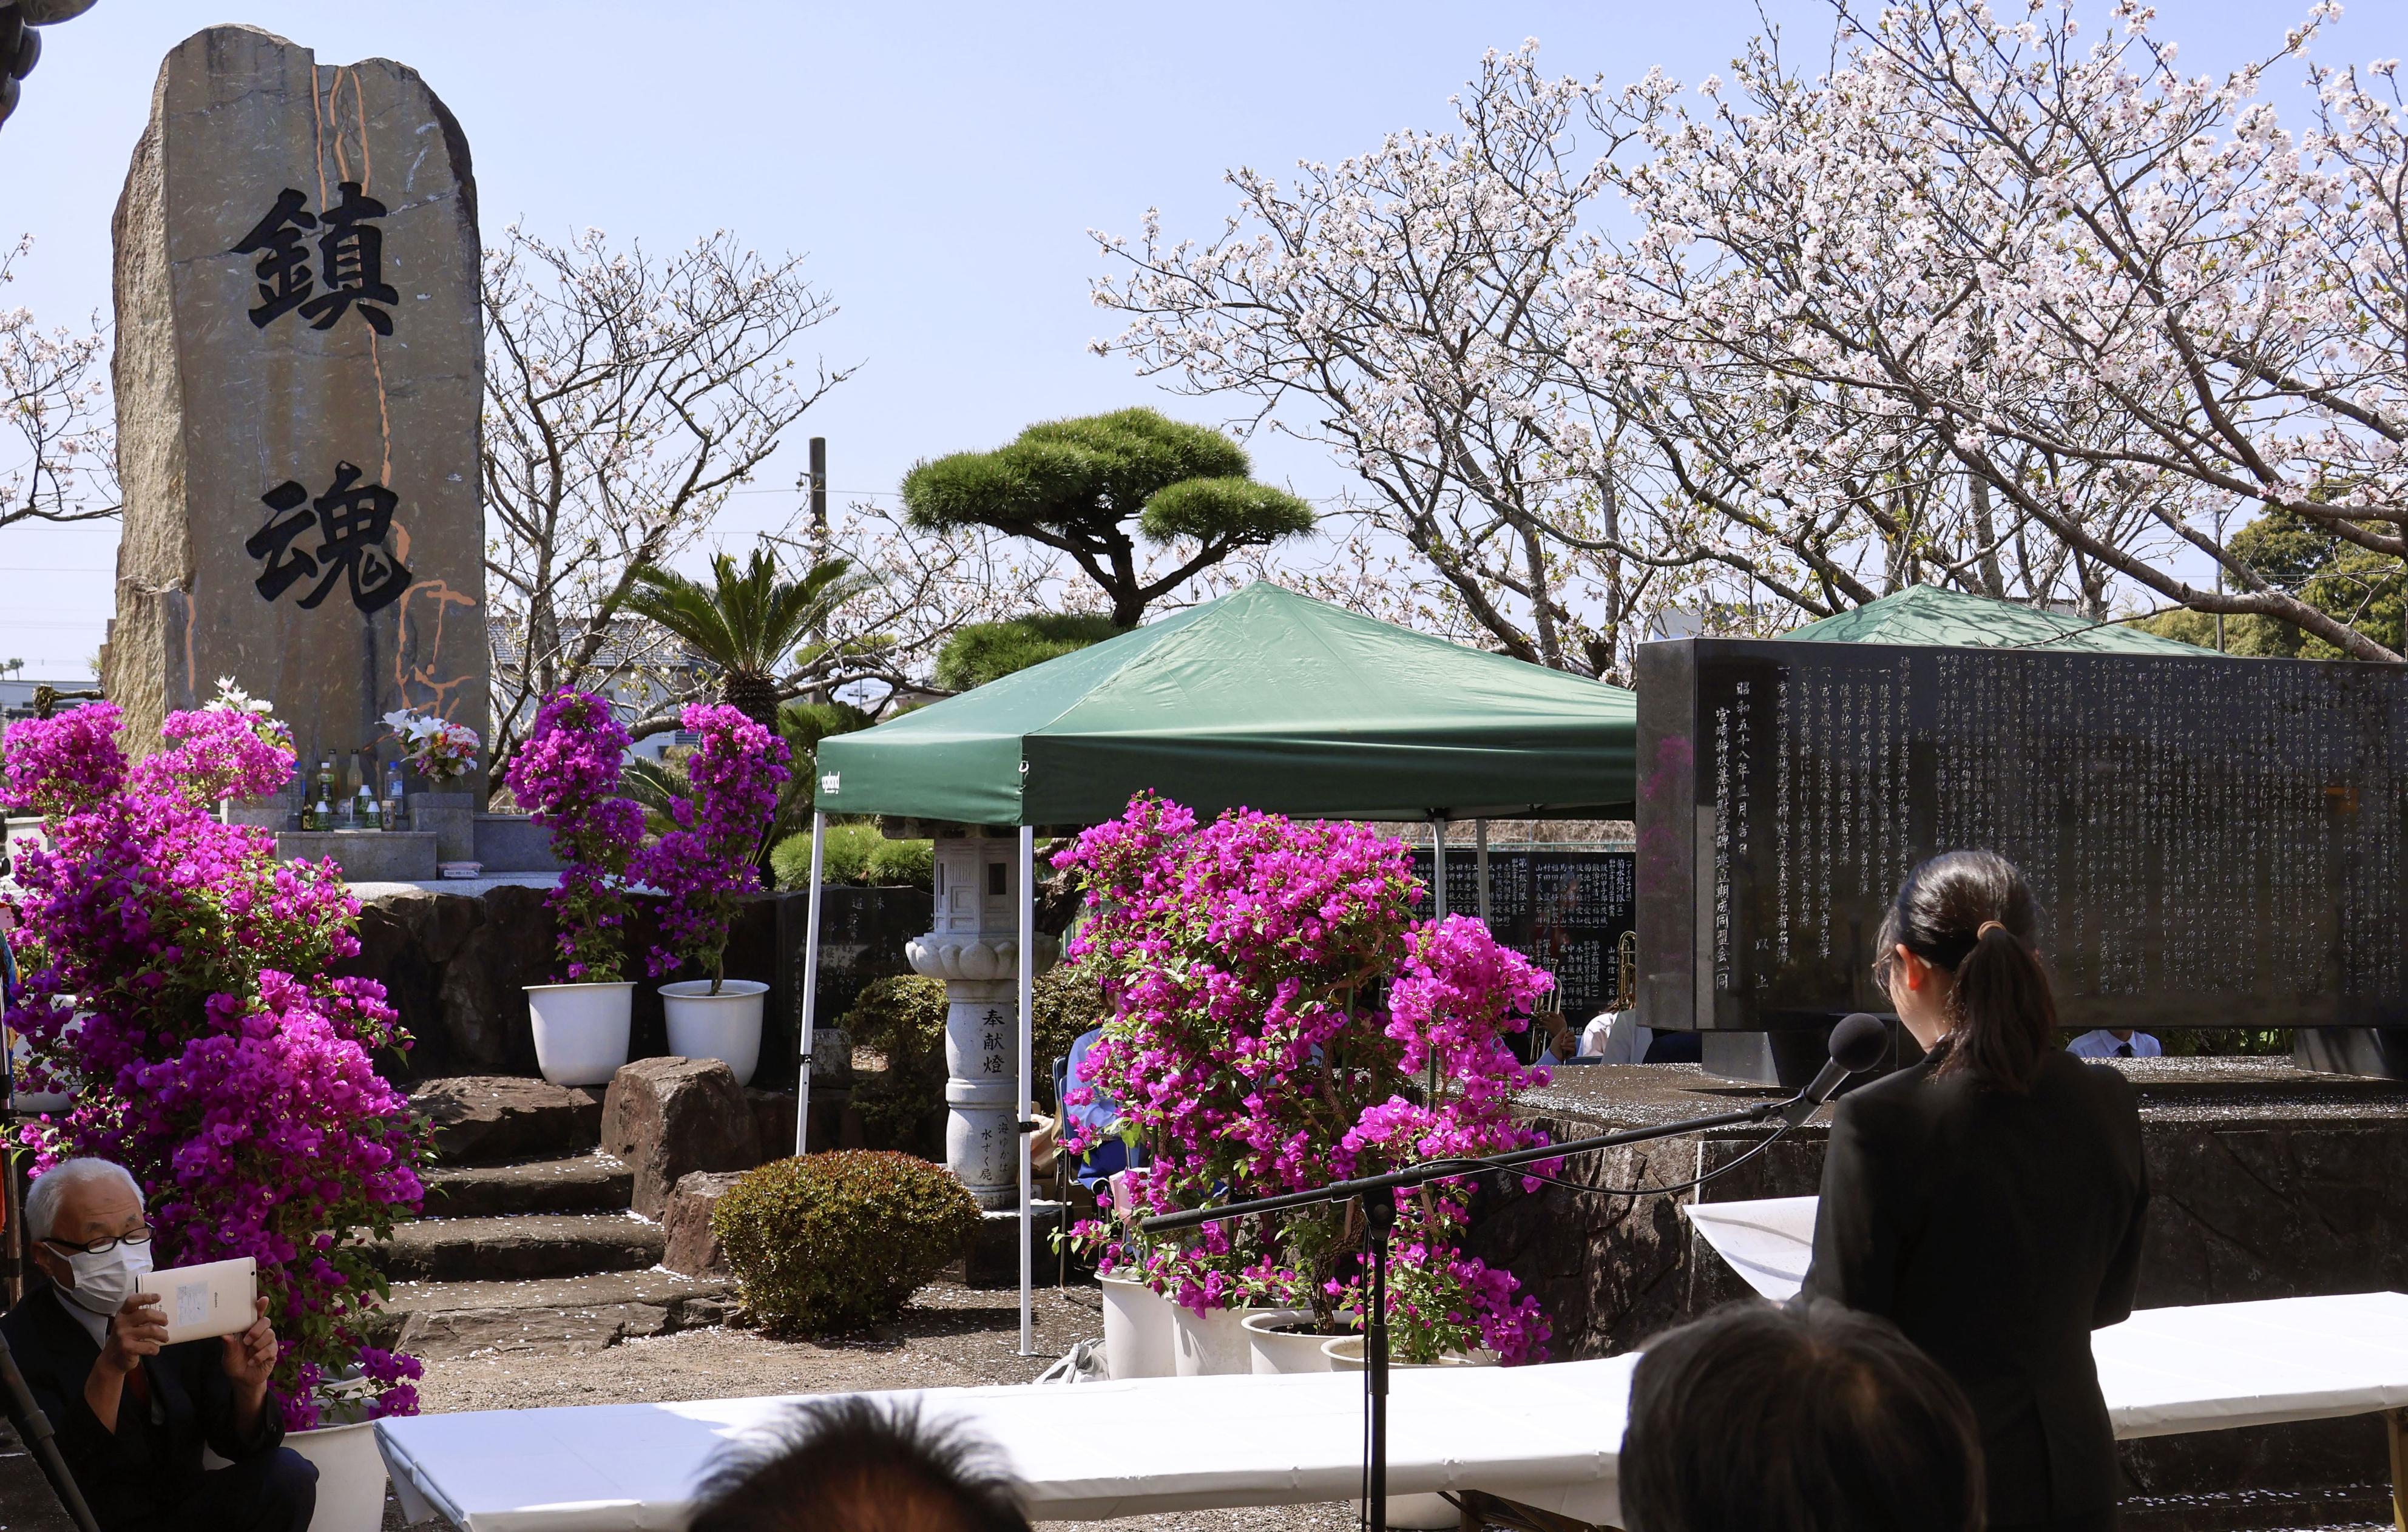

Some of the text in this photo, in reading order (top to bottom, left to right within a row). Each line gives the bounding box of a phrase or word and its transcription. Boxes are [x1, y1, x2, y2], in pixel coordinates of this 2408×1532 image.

[231, 181, 412, 609] 鎮魂
[1736, 681, 1751, 855] 昭和五十八年三月吉日
[982, 1009, 1005, 1073] 奉献燈
